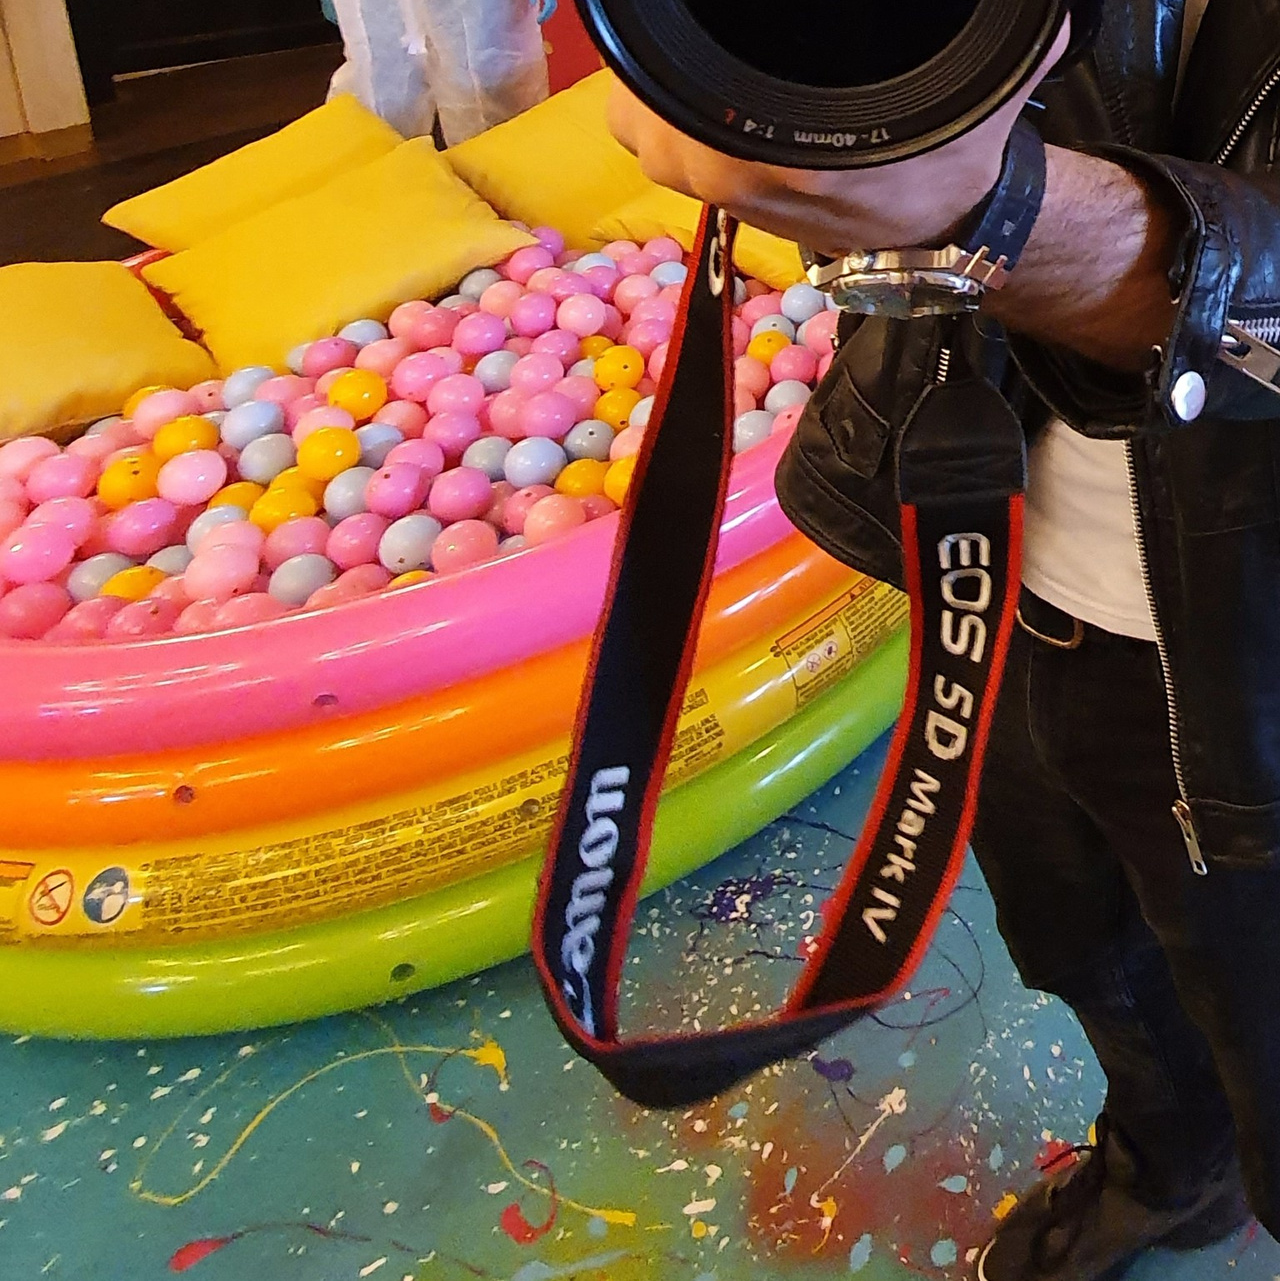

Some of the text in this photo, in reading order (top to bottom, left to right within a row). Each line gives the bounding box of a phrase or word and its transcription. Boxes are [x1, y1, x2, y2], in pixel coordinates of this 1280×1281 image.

[793, 127, 891, 148] 17-40mm
[862, 532, 992, 944] EOS 5D Mark IV
